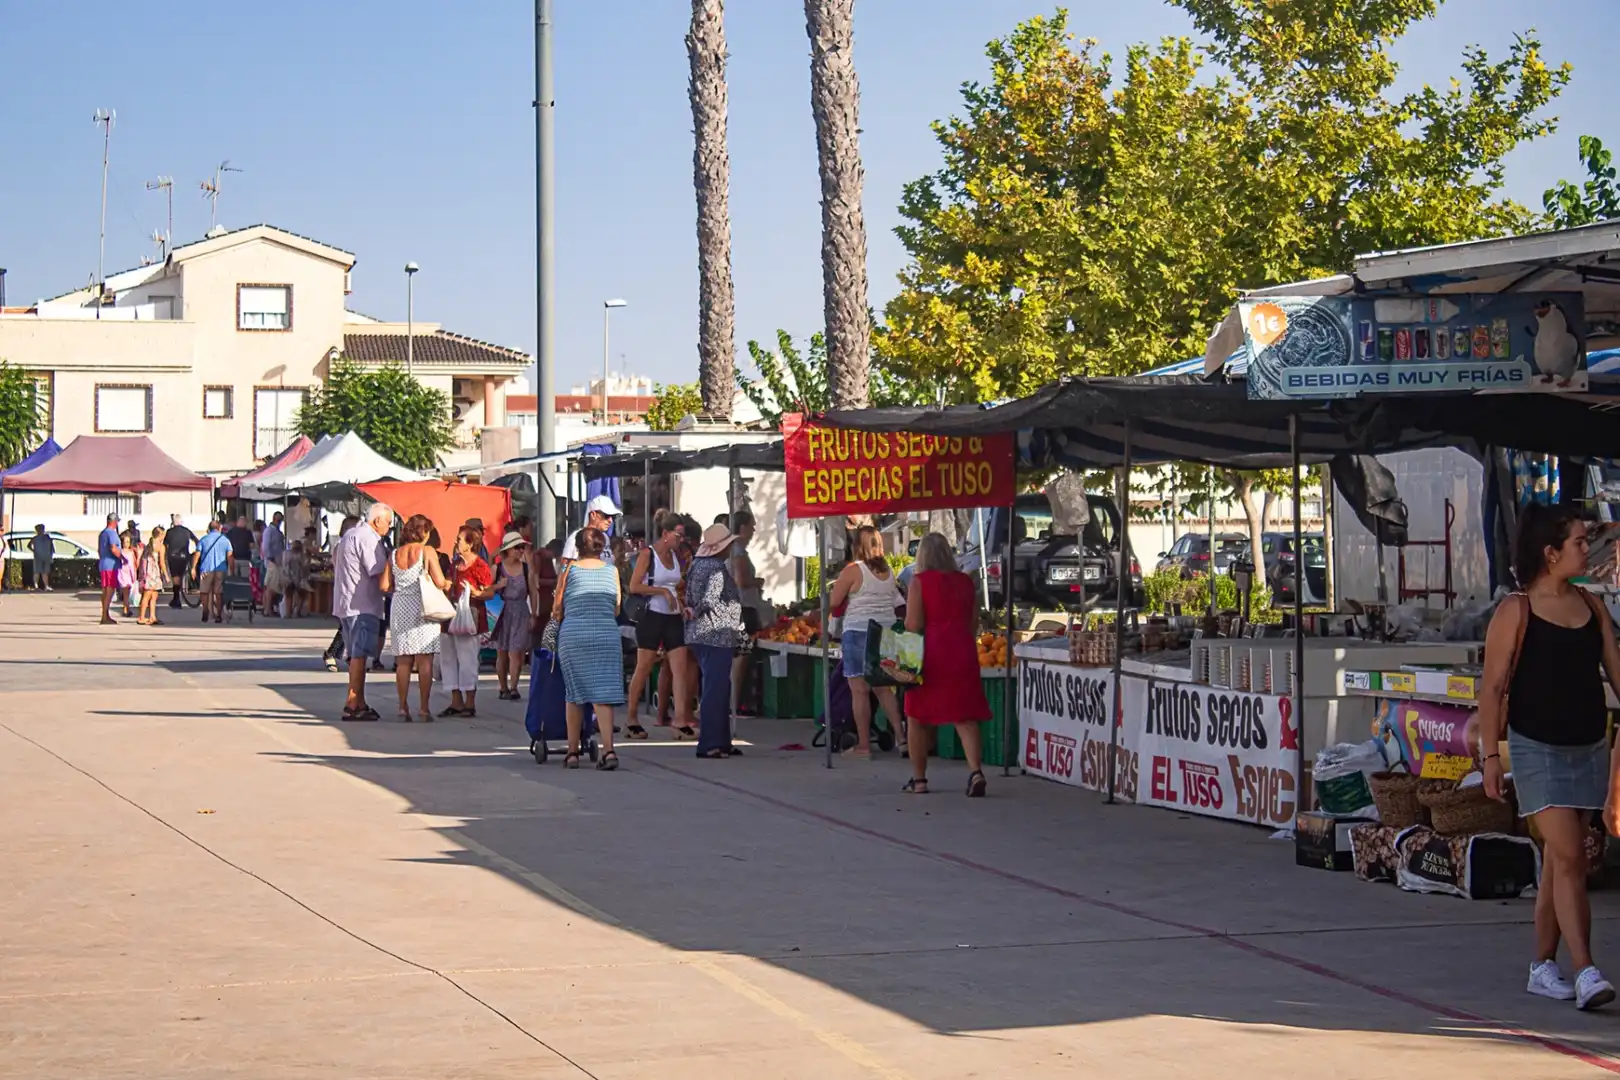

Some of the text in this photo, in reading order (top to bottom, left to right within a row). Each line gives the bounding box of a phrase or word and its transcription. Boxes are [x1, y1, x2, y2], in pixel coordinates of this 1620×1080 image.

[1254, 312, 1280, 335] 1€
[1288, 366, 1523, 387] BEBIDAS MUY FRÍAS
[808, 427, 890, 462] FRUTOS
[895, 431, 963, 458] SECOS
[803, 461, 993, 504] ESPECIAS EL TUSO
[1023, 659, 1064, 717] Frutos
[1146, 680, 1201, 742] Frutos
[1207, 693, 1268, 749] secos
[1025, 727, 1043, 770] EL
[1151, 755, 1178, 802] EL
